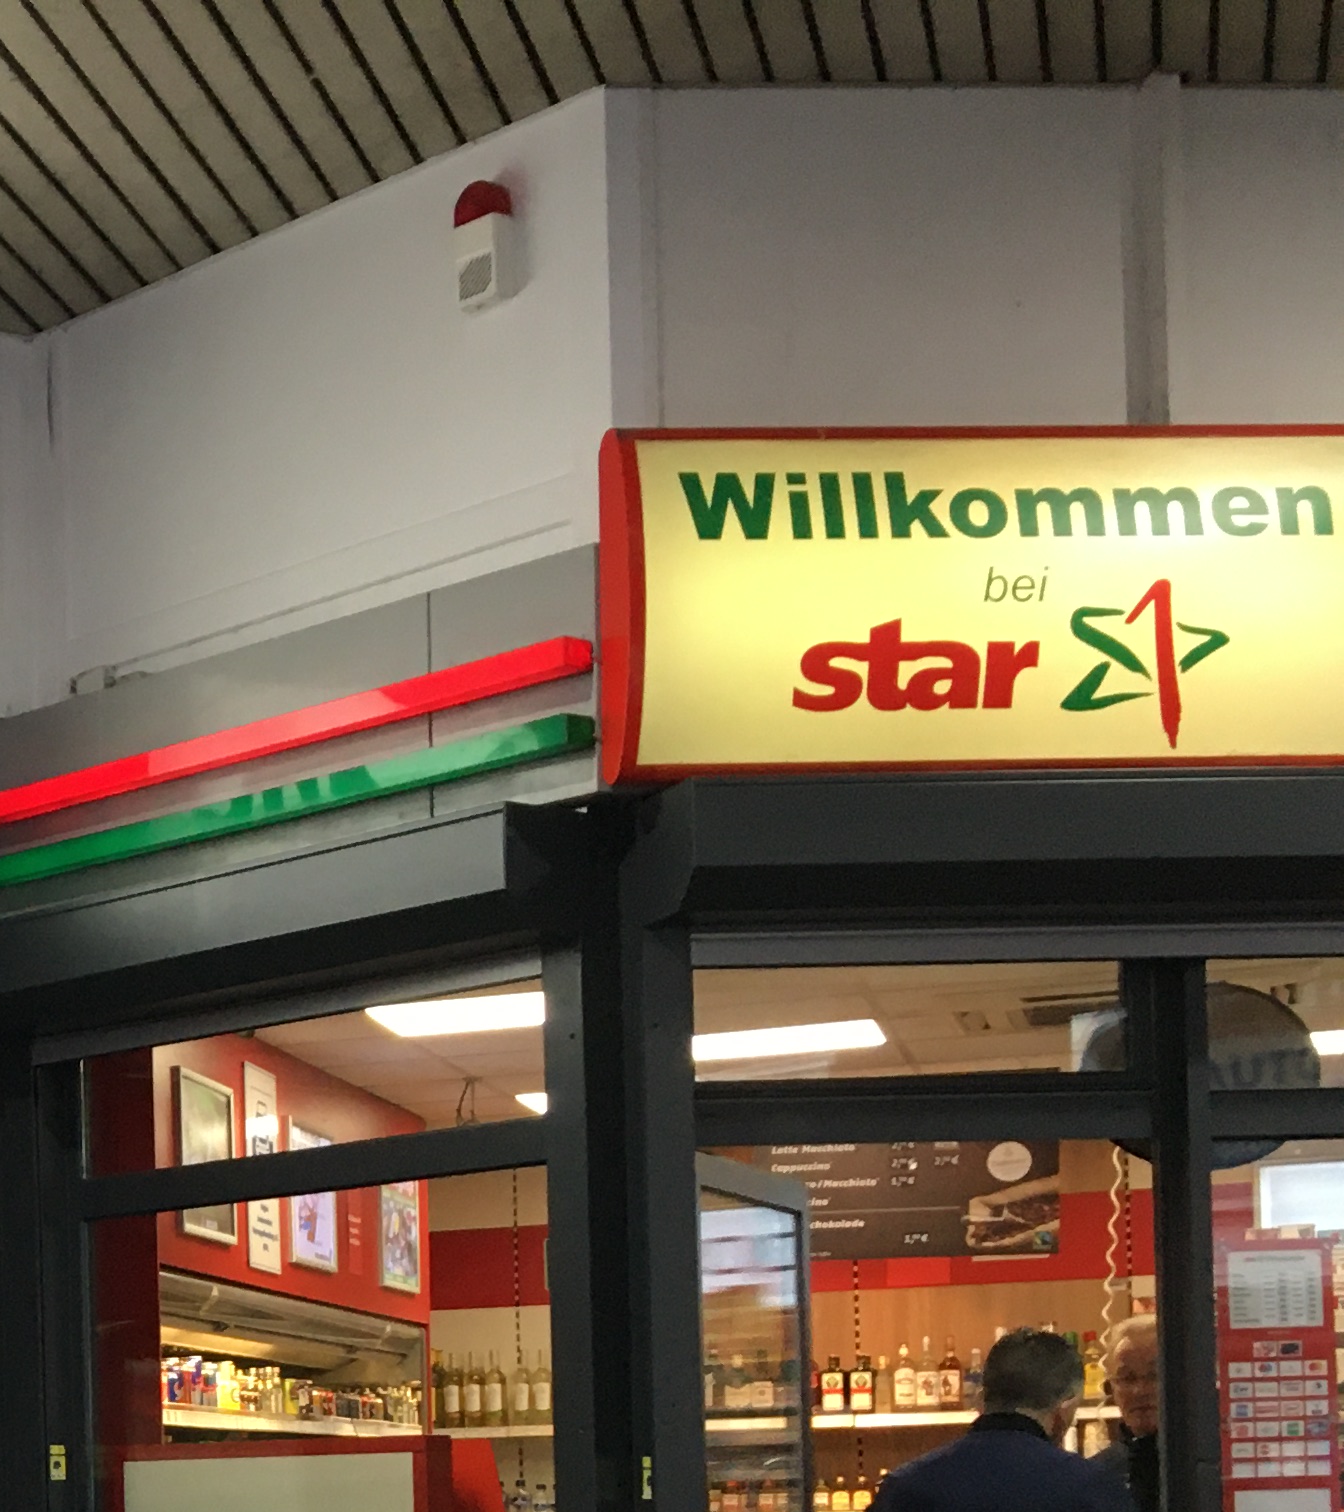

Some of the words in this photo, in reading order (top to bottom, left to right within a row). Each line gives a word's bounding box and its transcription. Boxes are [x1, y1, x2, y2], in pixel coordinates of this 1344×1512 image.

[678, 471, 1334, 541] Willkommen
[983, 566, 1050, 603] bei
[792, 617, 1041, 713] star
